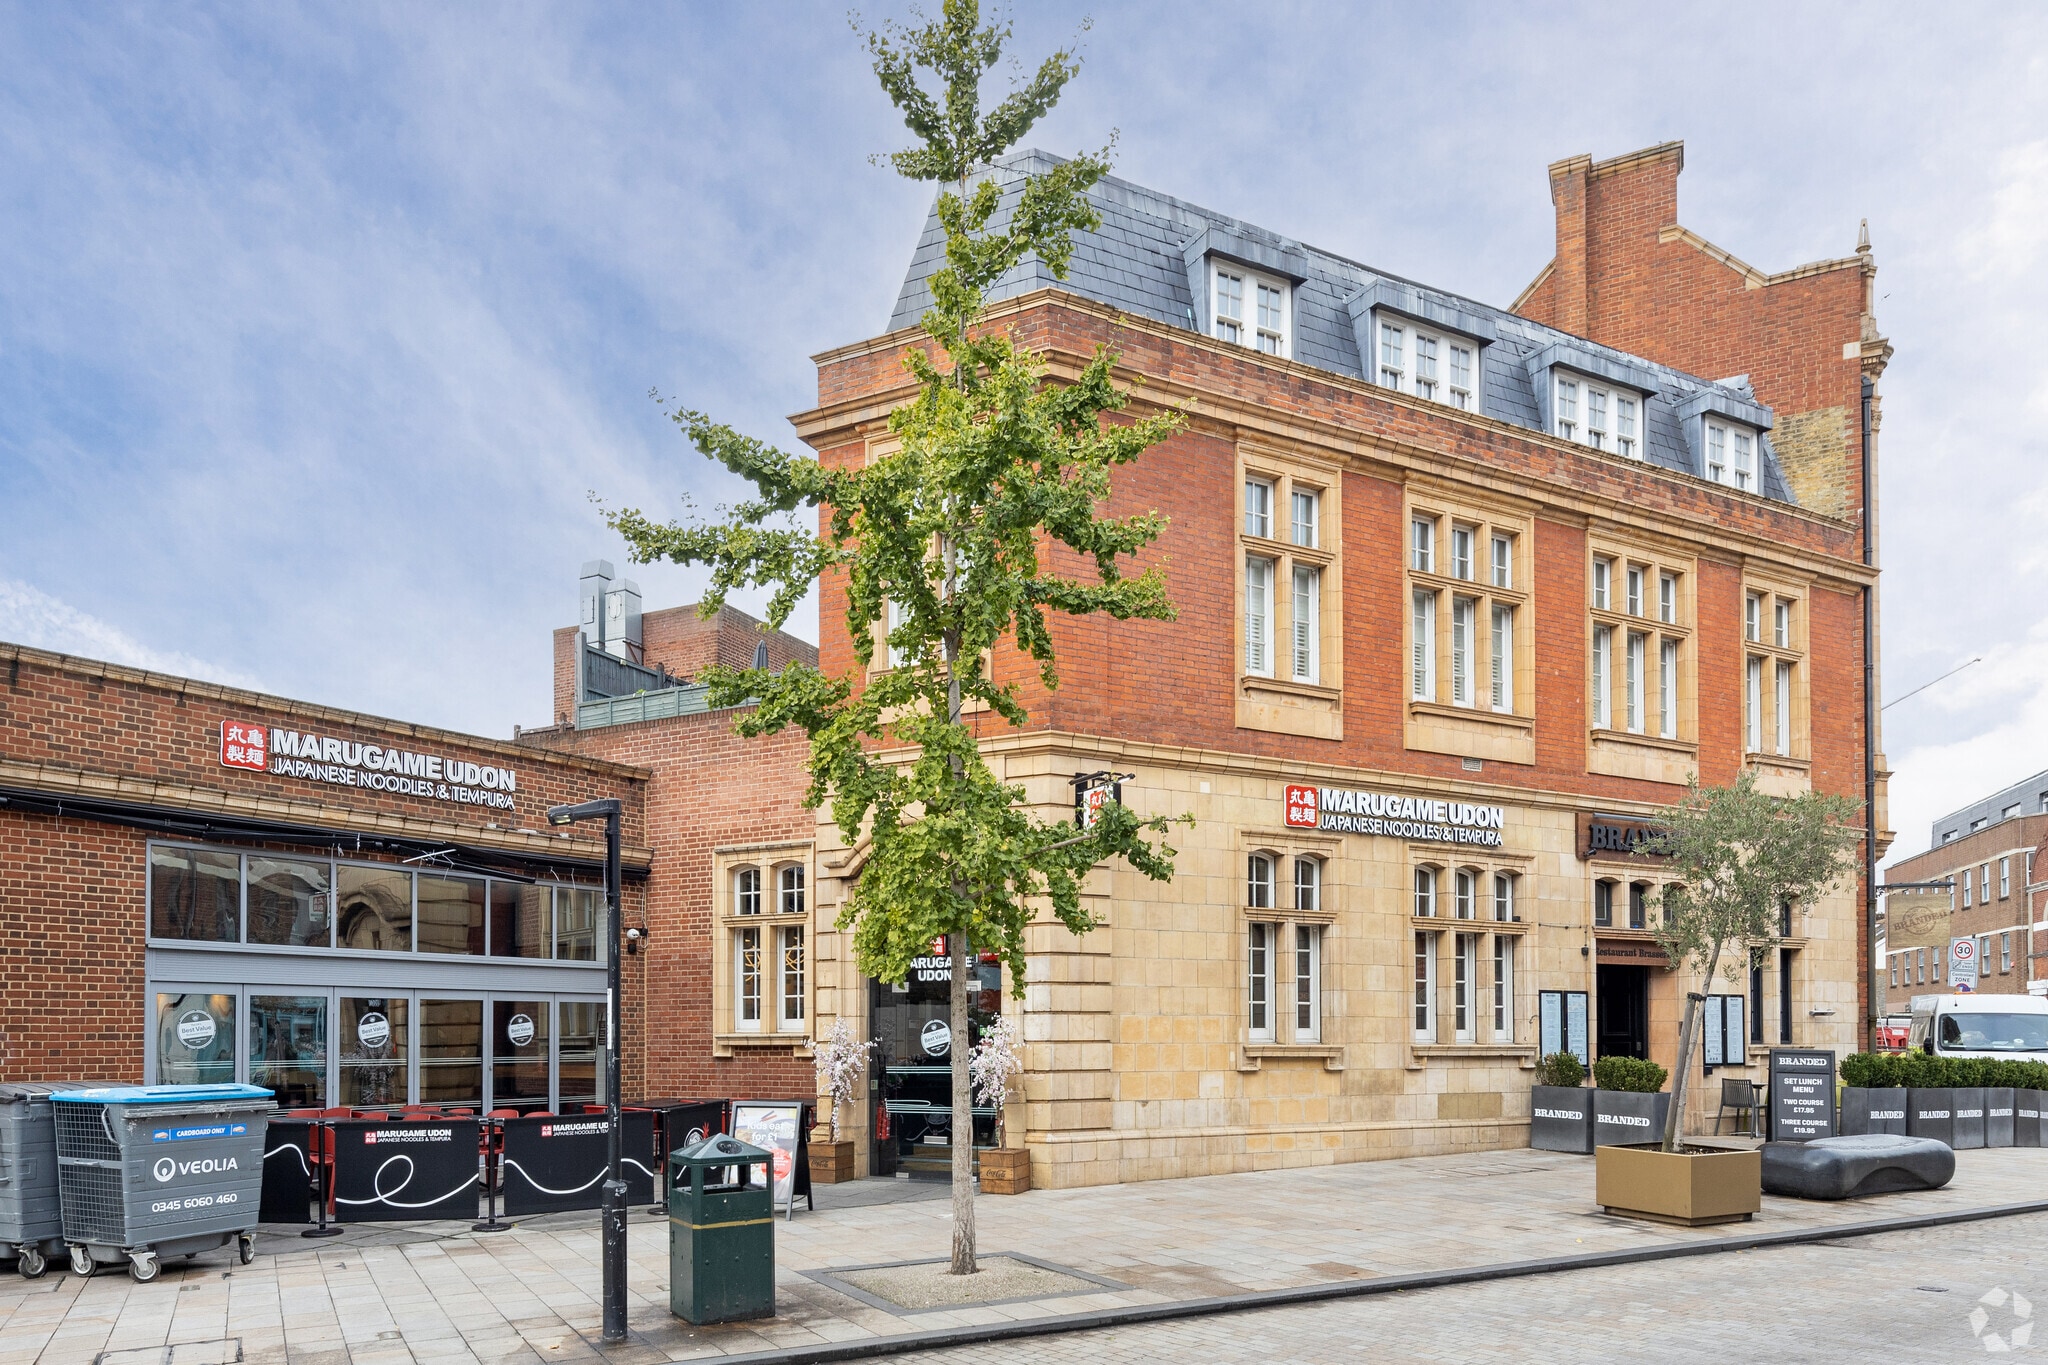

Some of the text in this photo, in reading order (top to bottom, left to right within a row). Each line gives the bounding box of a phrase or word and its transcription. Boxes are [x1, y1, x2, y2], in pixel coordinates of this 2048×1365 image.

[271, 728, 516, 792] MARUGAME UDON
[271, 757, 516, 810] JAPANESE NOODLES & TEMPURA
[1319, 788, 1504, 829] MARUGAME UDON
[1319, 814, 1504, 846] JAPANESE NOODLES & TEMPURA
[1638, 948, 1671, 959] Brasser
[1957, 946, 1971, 955] 30
[910, 956, 973, 969] ARUGAE
[917, 969, 952, 981] UDON
[1778, 1057, 1827, 1066] BRANDED
[1783, 1077, 1823, 1086] SET LUNCH
[1534, 1108, 1583, 1120] BRANDED
[1870, 1110, 1904, 1119] BRANDED
[1918, 1110, 1950, 1119] BRANDED
[1957, 1109, 1983, 1118] BRANDED
[1989, 1108, 2013, 1117] BRANDED
[2018, 1109, 2038, 1118] BRANDED
[1597, 1114, 1651, 1127] BRANDED
[1781, 1118, 1801, 1126] THREE
[553, 1123, 597, 1131] MARUGAME
[747, 1121, 767, 1130] Kids
[176, 1129, 211, 1137] CARDBOARD
[376, 1129, 427, 1138] MARUGAME
[752, 1131, 766, 1141] for
[178, 1157, 239, 1176] VEOLIA
[151, 1193, 238, 1213] 0345 6060 460
